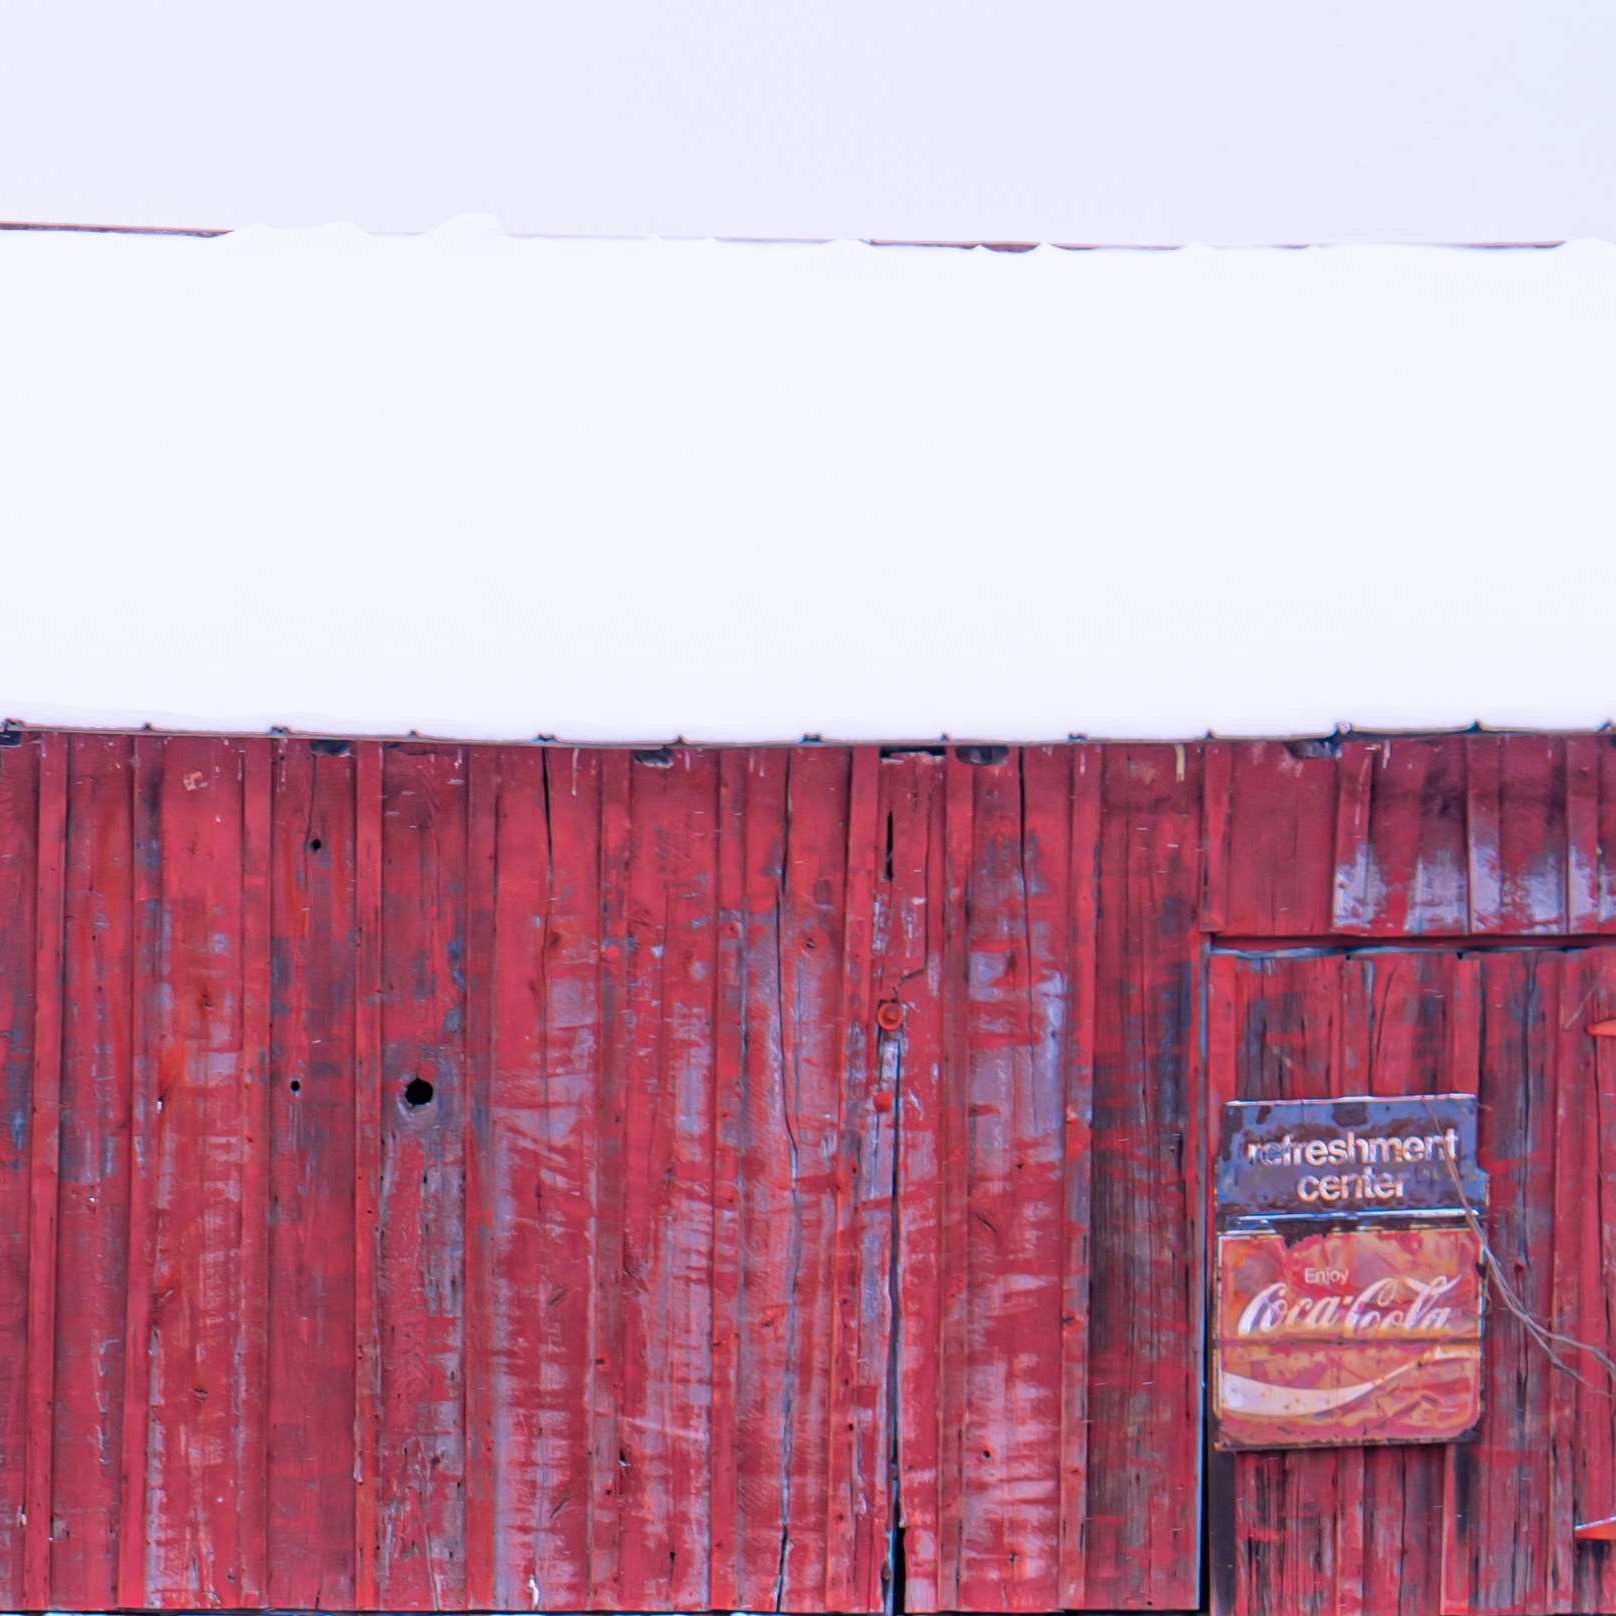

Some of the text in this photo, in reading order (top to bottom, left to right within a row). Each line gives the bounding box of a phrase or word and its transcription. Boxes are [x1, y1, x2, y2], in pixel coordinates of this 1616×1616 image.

[1247, 1128, 1458, 1167] refreshment
[1297, 1166, 1409, 1201] center
[1304, 1267, 1350, 1286] Enjoy
[1237, 1275, 1462, 1338] Coca-Cola
